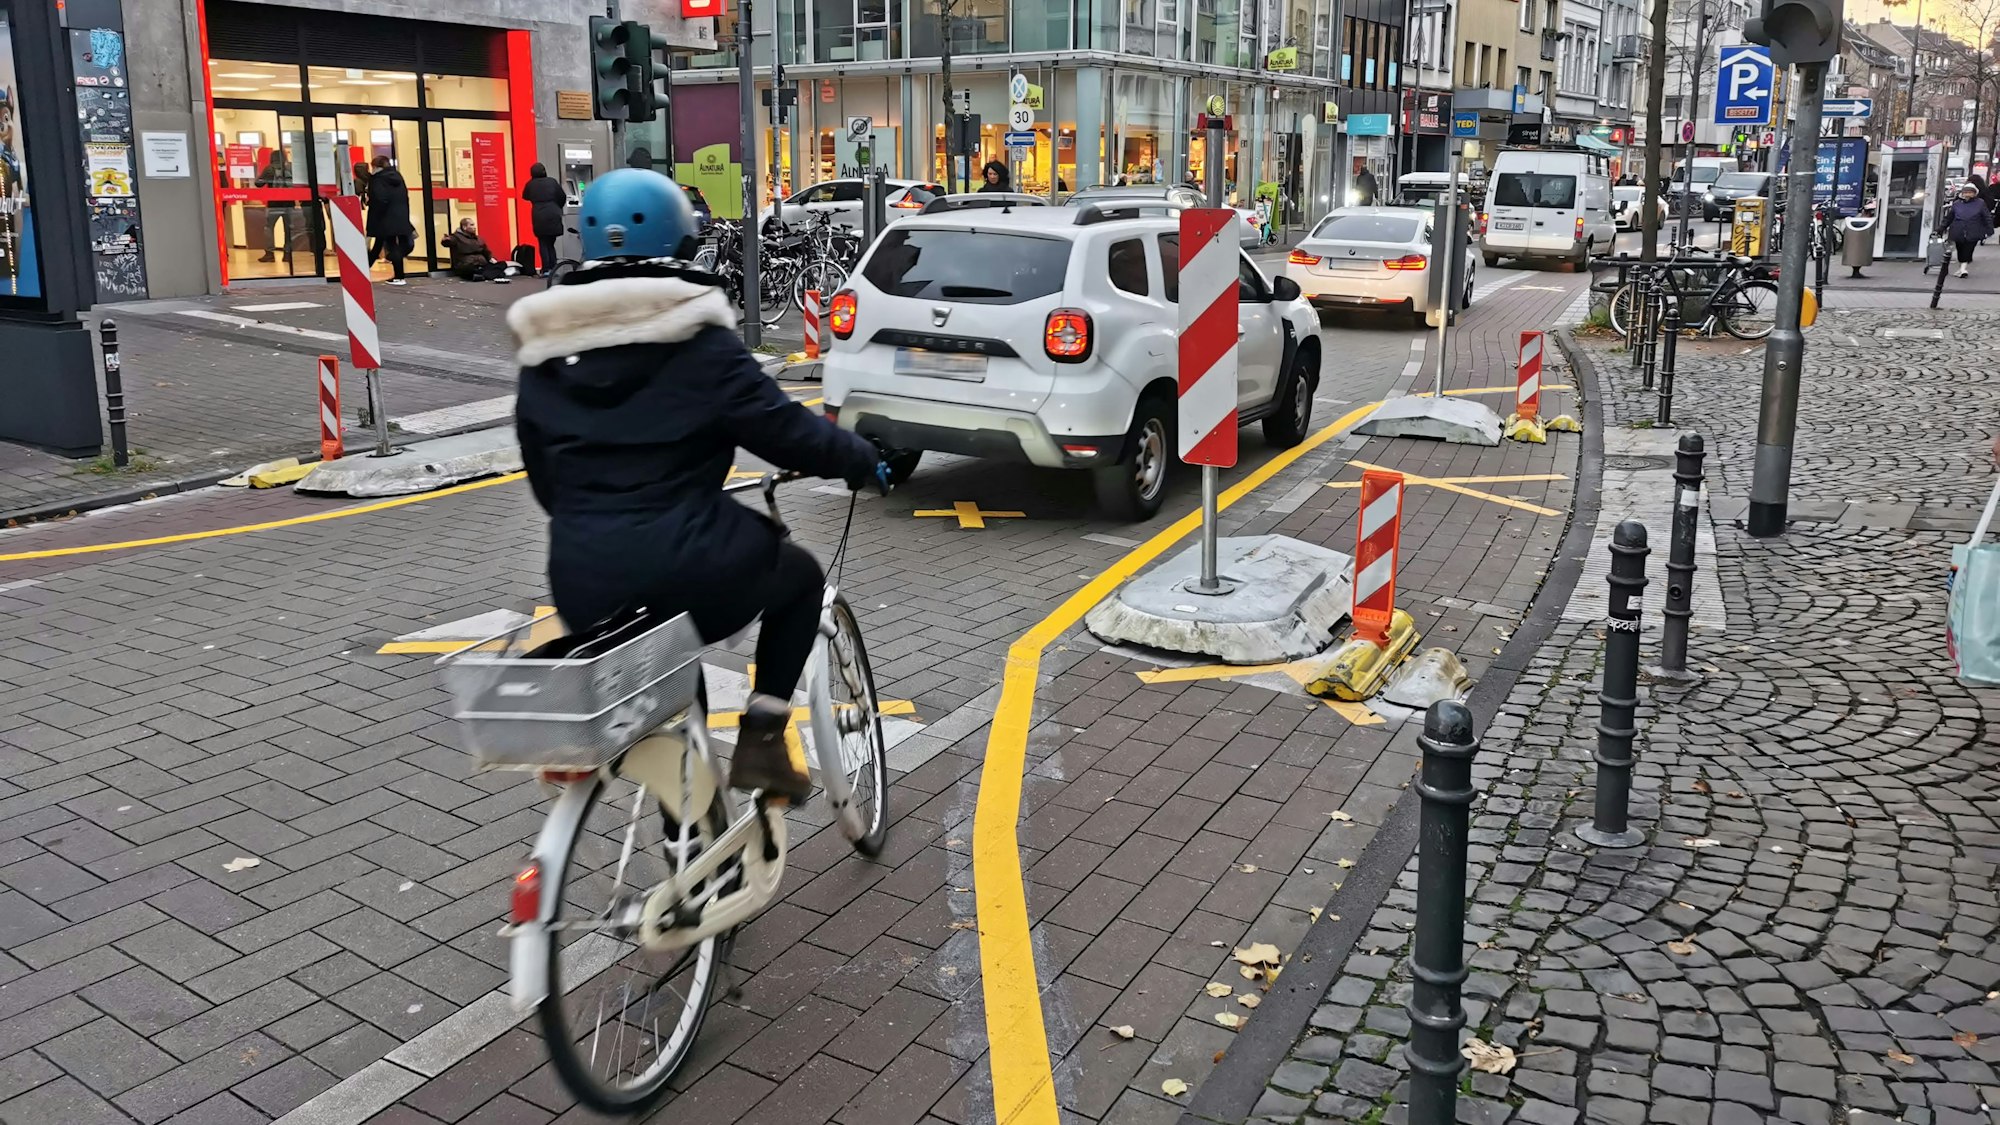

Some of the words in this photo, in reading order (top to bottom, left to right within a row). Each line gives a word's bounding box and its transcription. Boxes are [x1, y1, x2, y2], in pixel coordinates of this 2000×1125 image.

[1729, 63, 1759, 100] P
[1014, 111, 1029, 123] 30
[1728, 107, 1756, 117] BESETZT
[855, 122, 865, 131] 20
[1456, 119, 1476, 128] TEDi
[1909, 120, 1922, 134] T
